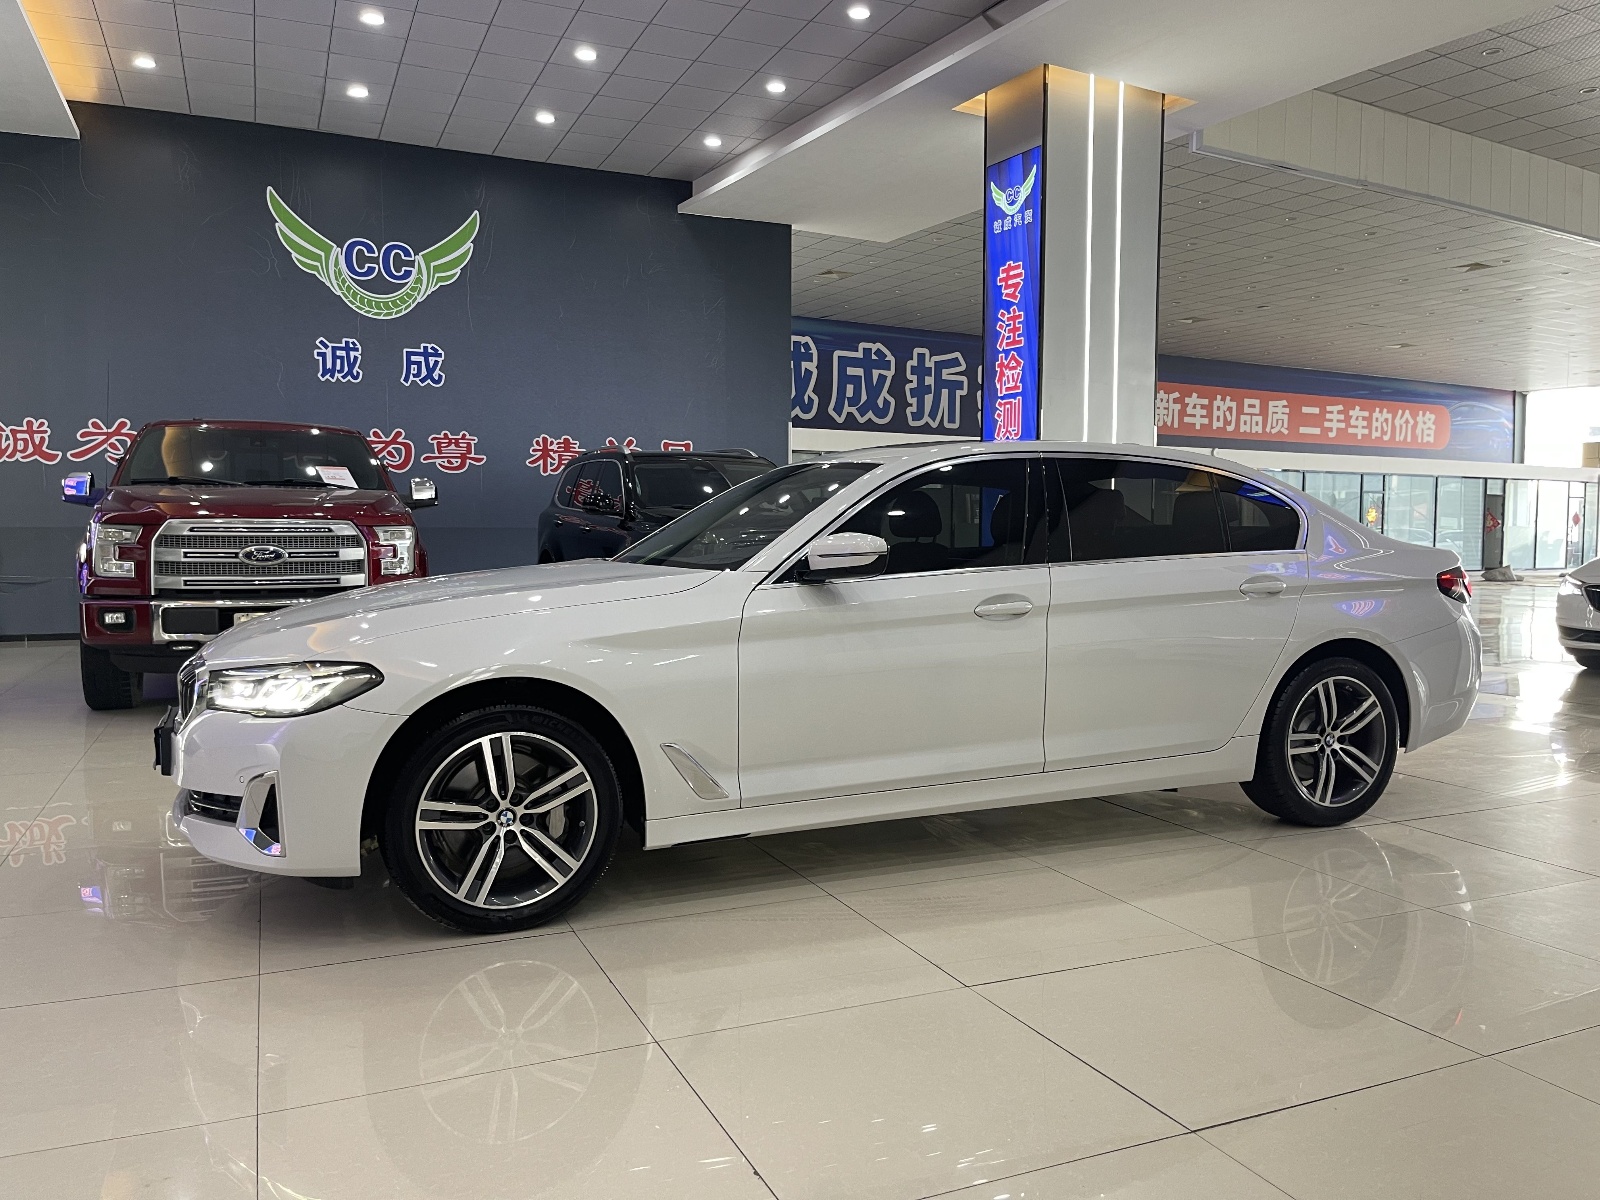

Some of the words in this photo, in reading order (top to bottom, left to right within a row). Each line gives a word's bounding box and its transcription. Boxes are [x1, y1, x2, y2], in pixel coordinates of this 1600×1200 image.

[1006, 186, 1022, 203] CC
[342, 237, 415, 284] CC
[314, 337, 446, 388] 诚成
[994, 260, 1025, 441] 专注检测
[791, 334, 982, 430] 成折
[1155, 390, 1290, 435] 新车的品质
[1299, 404, 1436, 444] 二手车的价格
[251, 550, 276, 561] Ford
